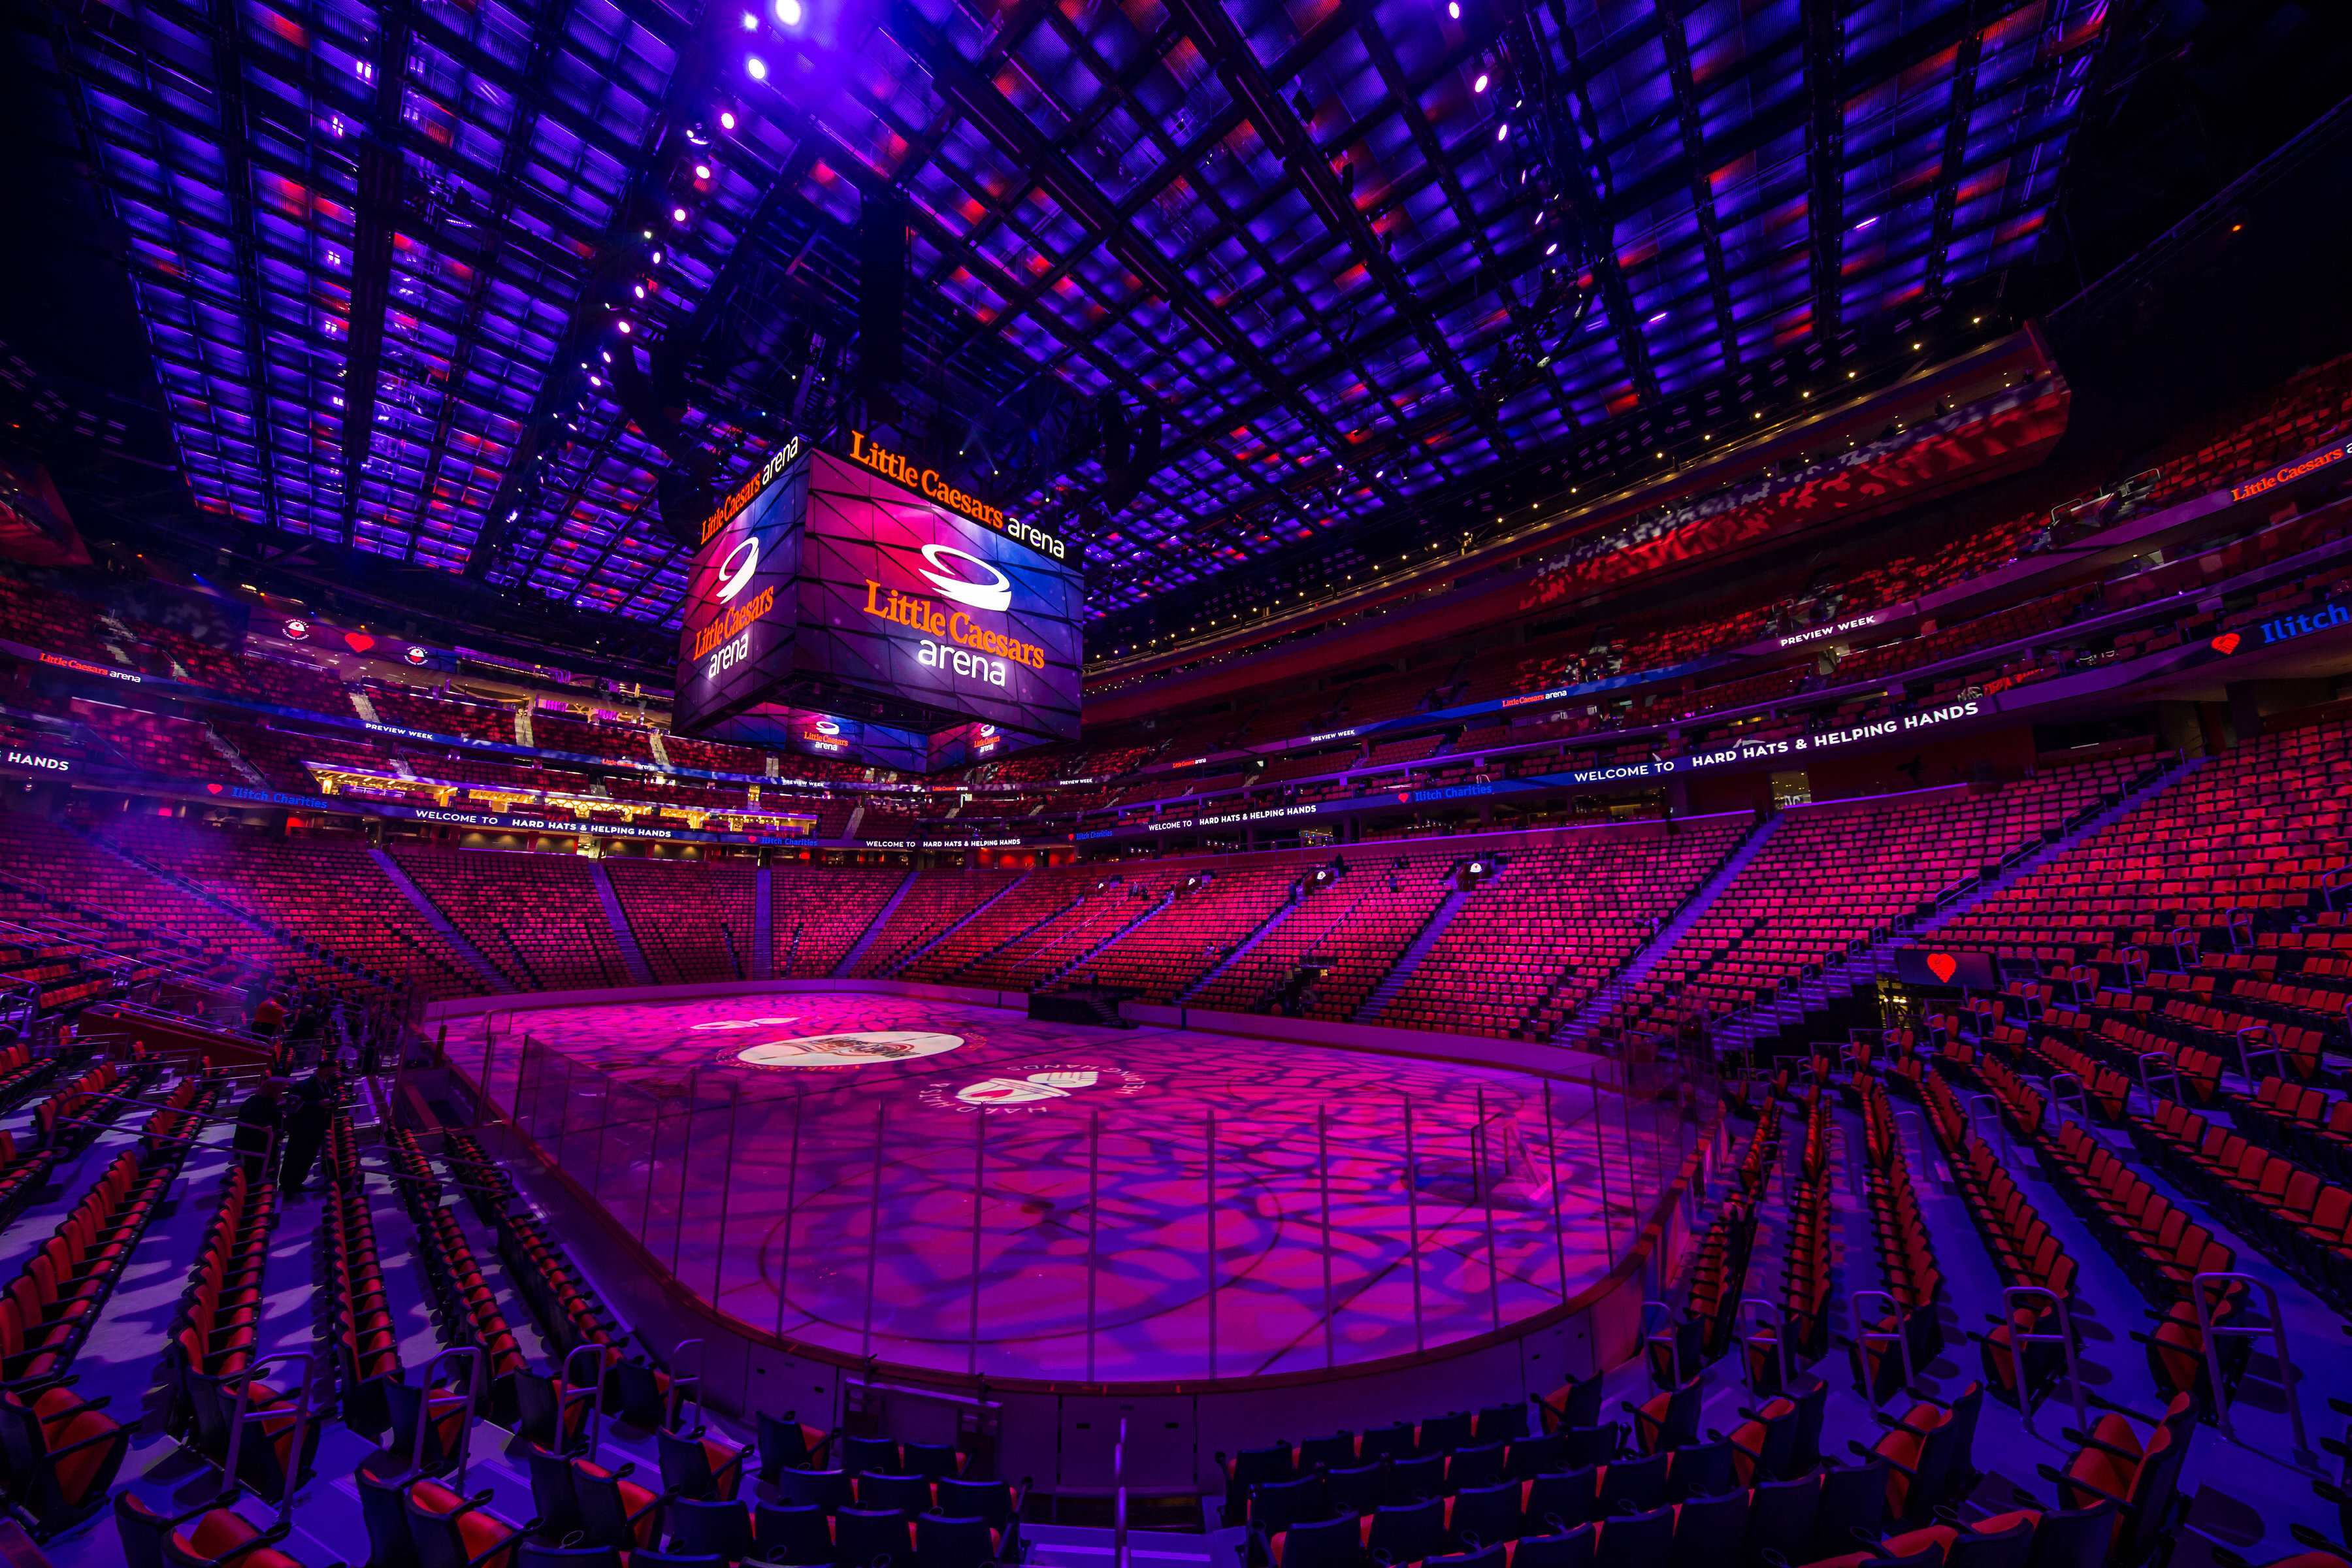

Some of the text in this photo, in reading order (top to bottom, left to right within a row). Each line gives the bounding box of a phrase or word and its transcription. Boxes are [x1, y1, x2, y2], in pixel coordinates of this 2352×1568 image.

[2230, 448, 2344, 502] Little Caesars
[701, 436, 798, 545] Little Caesars arena
[849, 430, 1065, 559] Little Caesars arena
[693, 585, 774, 661] Little Caesars
[863, 579, 1045, 668] Little Caesars
[1781, 615, 1876, 647] PREVIEW WEEK
[2260, 603, 2350, 644] Ilitch
[39, 653, 141, 683] Little Caesars arena
[709, 633, 749, 678] arena
[918, 639, 1005, 687] arena
[1502, 690, 1567, 708] Little Caesars arena
[366, 723, 433, 740] PREVIEW WEEK
[804, 731, 848, 747] Little Caesars
[1311, 732, 1336, 742] PREVIEW
[1574, 702, 1978, 783] WELCOME TO HARD HATS & HELPING HANDS
[815, 742, 838, 751] arena
[980, 743, 993, 753] arena
[8, 752, 69, 771] HANDS
[231, 787, 327, 809] Ilitch Charities
[1415, 785, 1492, 801] Ilitch Charities
[416, 809, 477, 823] WELCOME
[512, 819, 544, 828] HARD
[548, 822, 576, 830] HATS
[591, 825, 635, 835] HELPING
[638, 829, 671, 838] HANDS
[1149, 821, 1181, 831] WELCOME
[1200, 817, 1219, 825] HARD
[1221, 814, 1240, 823] HATS
[1250, 809, 1284, 820] HELPING
[1287, 805, 1316, 815] HANDS
[785, 838, 817, 847] Charities
[1076, 830, 1113, 840] Ilitch Charities
[1102, 1067, 1146, 1095] HELPING
[919, 1088, 955, 1108] HATS
